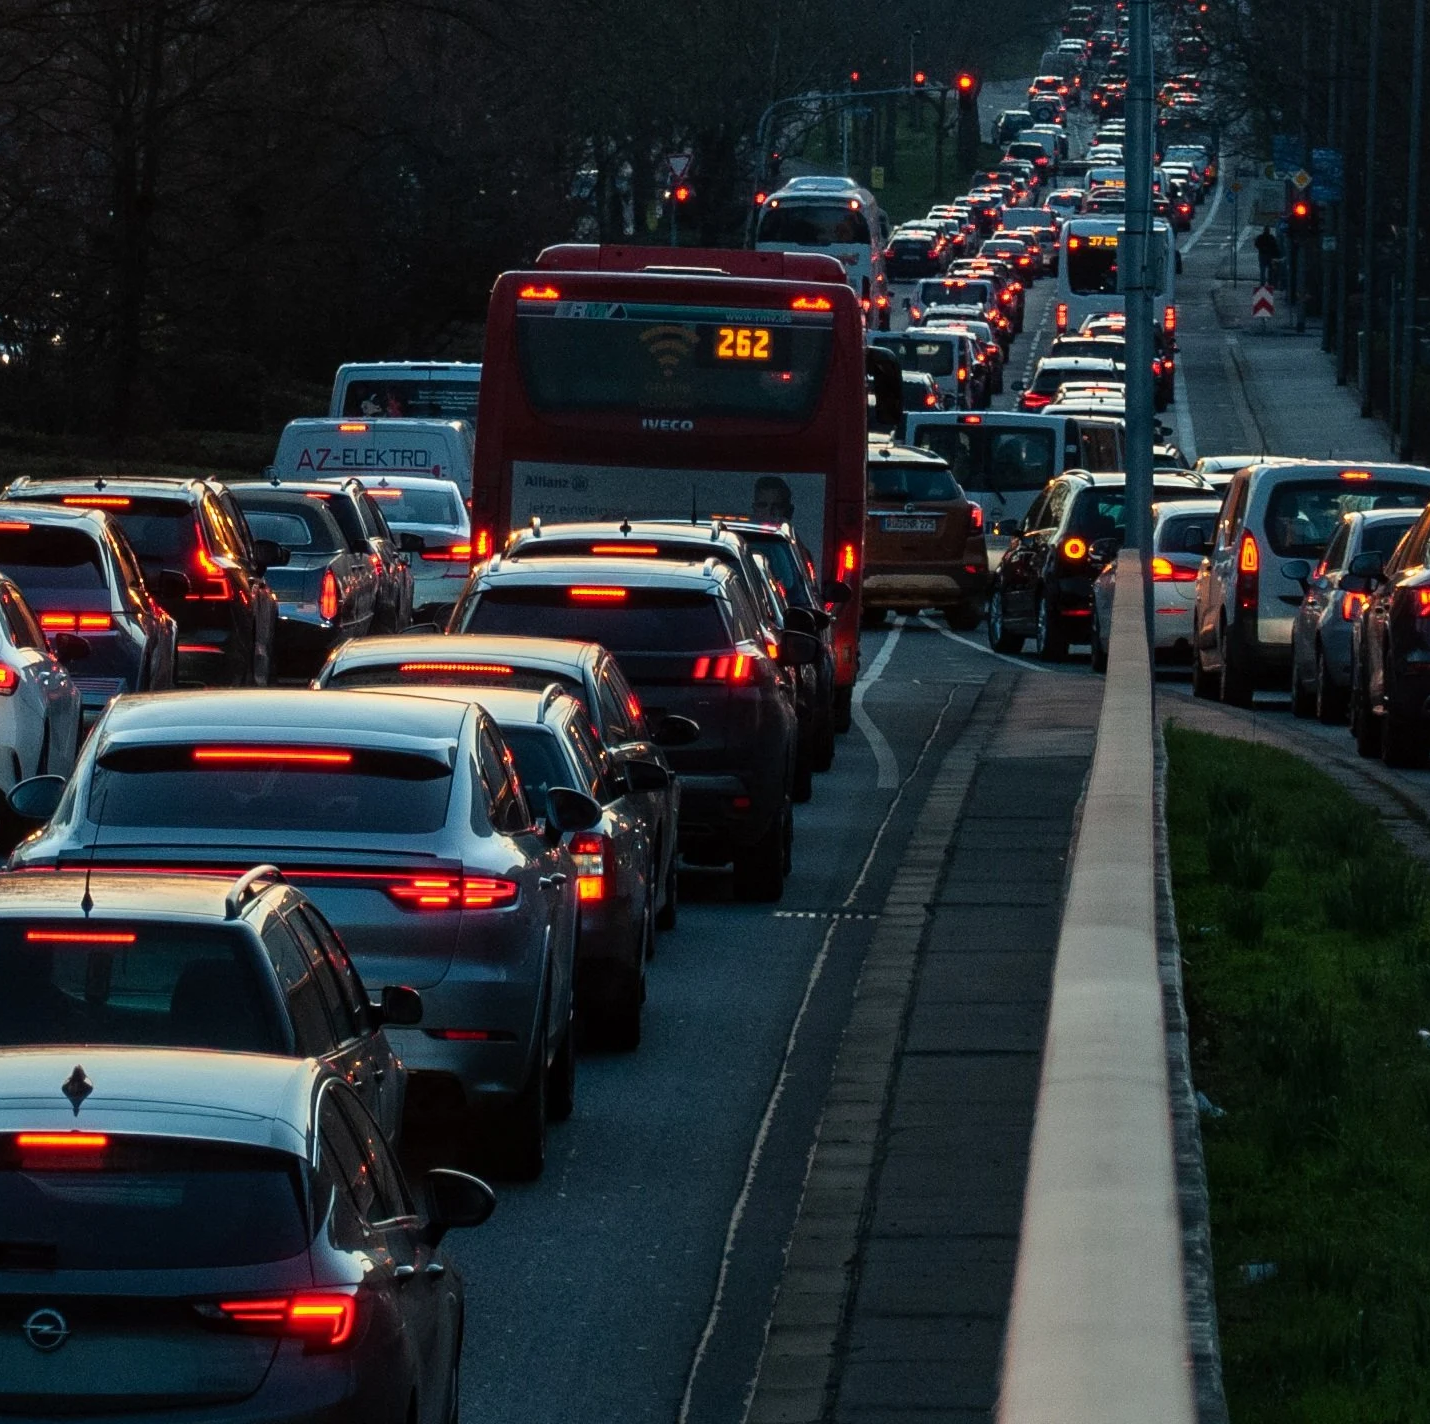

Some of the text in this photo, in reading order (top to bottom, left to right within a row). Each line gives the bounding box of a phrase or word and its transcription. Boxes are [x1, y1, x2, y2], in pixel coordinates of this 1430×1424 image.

[717, 328, 770, 359] 262
[642, 418, 694, 432] IVECO
[296, 448, 428, 471] AZ-ELEKTRO
[524, 475, 569, 489] Allianz
